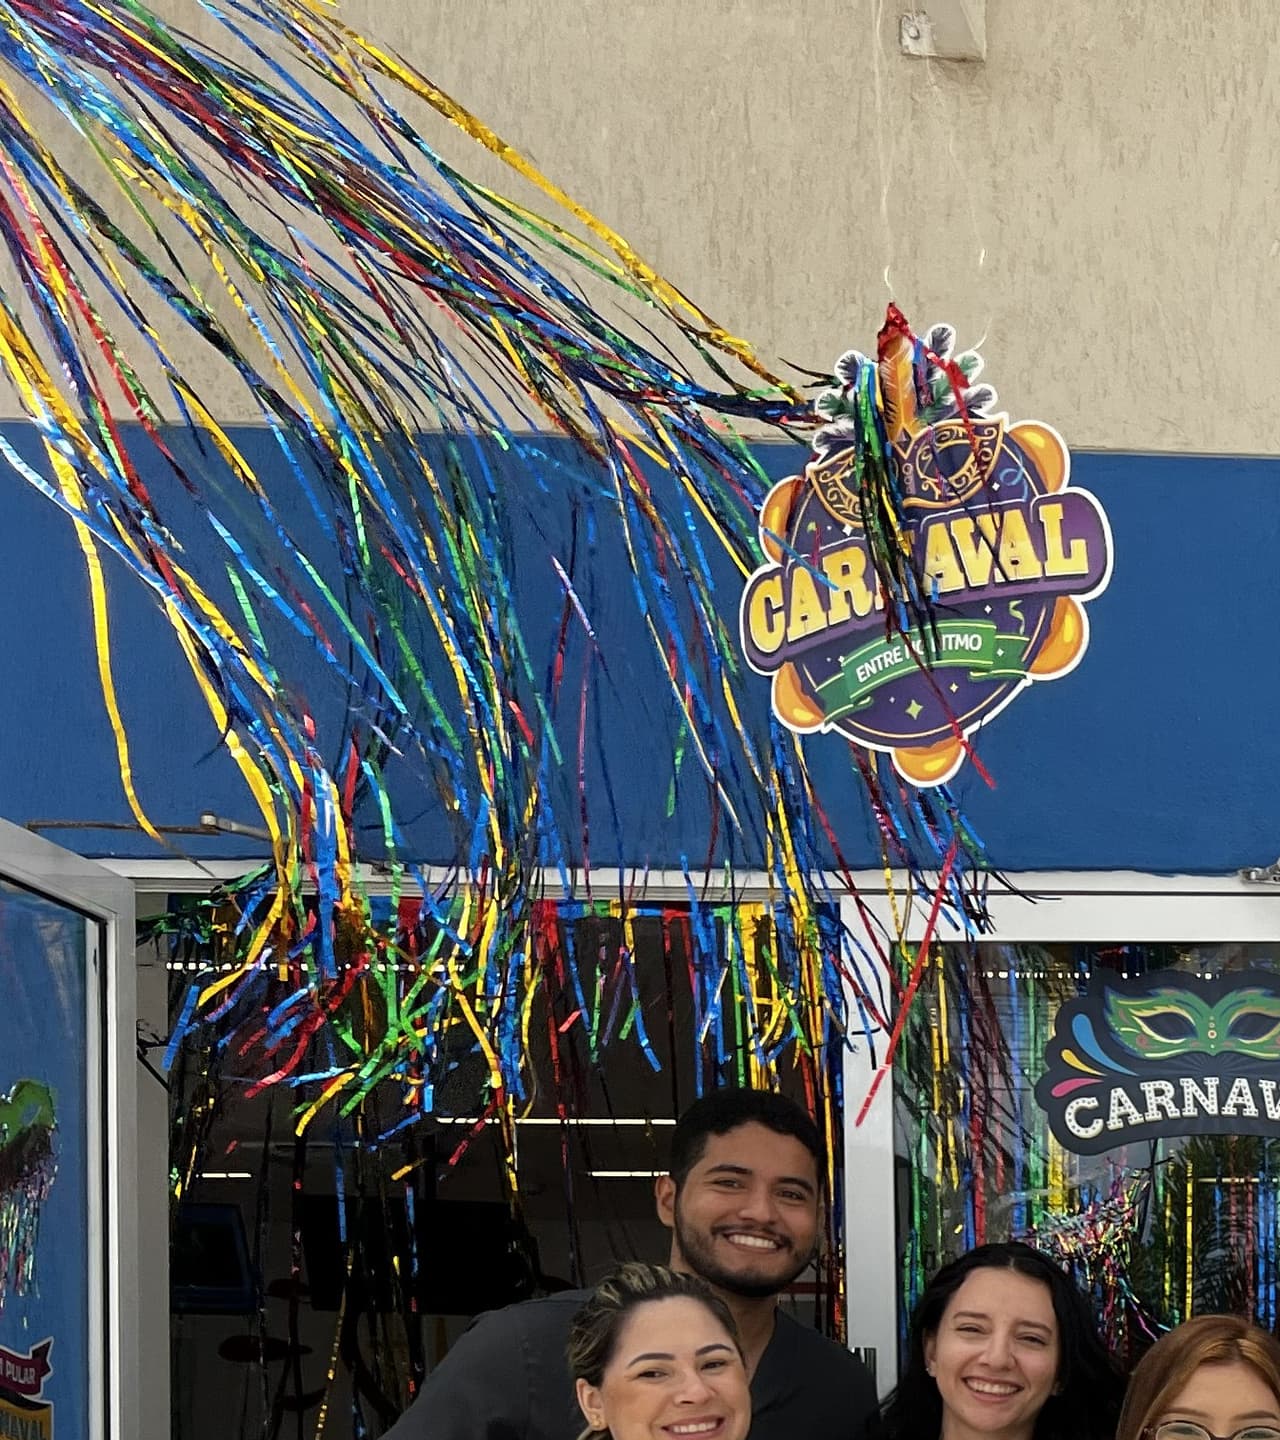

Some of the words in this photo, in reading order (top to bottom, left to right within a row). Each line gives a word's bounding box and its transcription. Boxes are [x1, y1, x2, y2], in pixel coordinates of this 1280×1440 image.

[749, 503, 1088, 653] CARAVAL
[856, 646, 904, 682] ENTRE
[6, 1361, 36, 1385] PULAR
